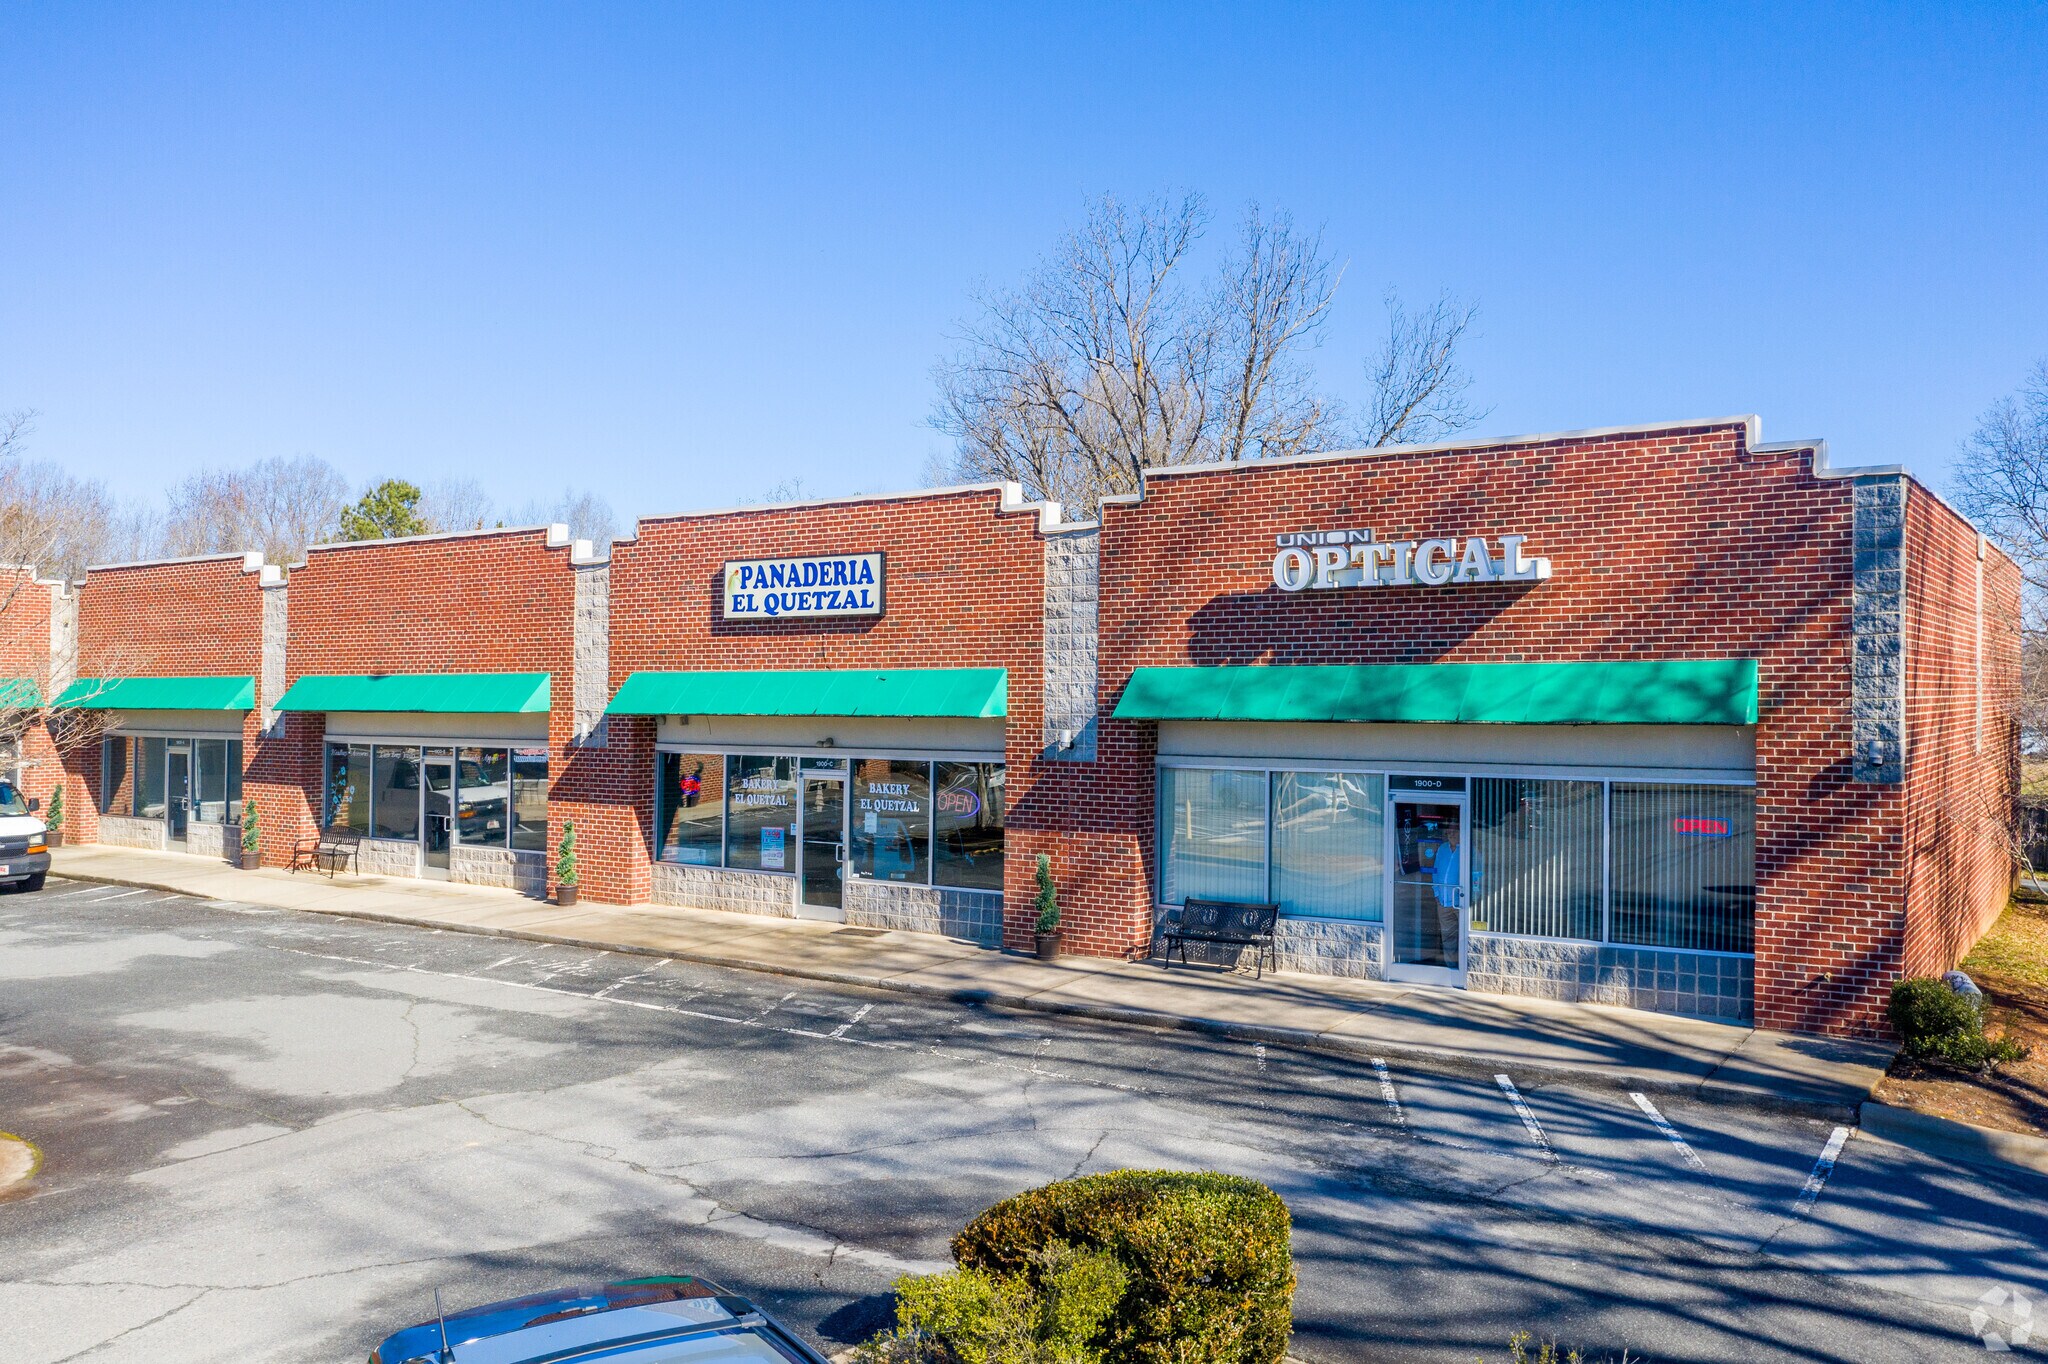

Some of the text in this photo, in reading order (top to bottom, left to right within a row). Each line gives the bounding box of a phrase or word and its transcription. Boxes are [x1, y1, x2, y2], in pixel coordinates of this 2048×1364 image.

[1276, 529, 1370, 547] UNION
[1272, 535, 1551, 591] OPTICAL
[739, 558, 875, 590] PANADERIA
[731, 589, 875, 616] EL QUETZAL
[742, 779, 779, 790] BAKERY
[869, 782, 910, 795] BAKERY
[735, 793, 788, 806] EL QUETZAL
[860, 798, 919, 812] EL QUETZAL
[937, 793, 973, 813] OPEN
[1674, 818, 1728, 834] OPEN
